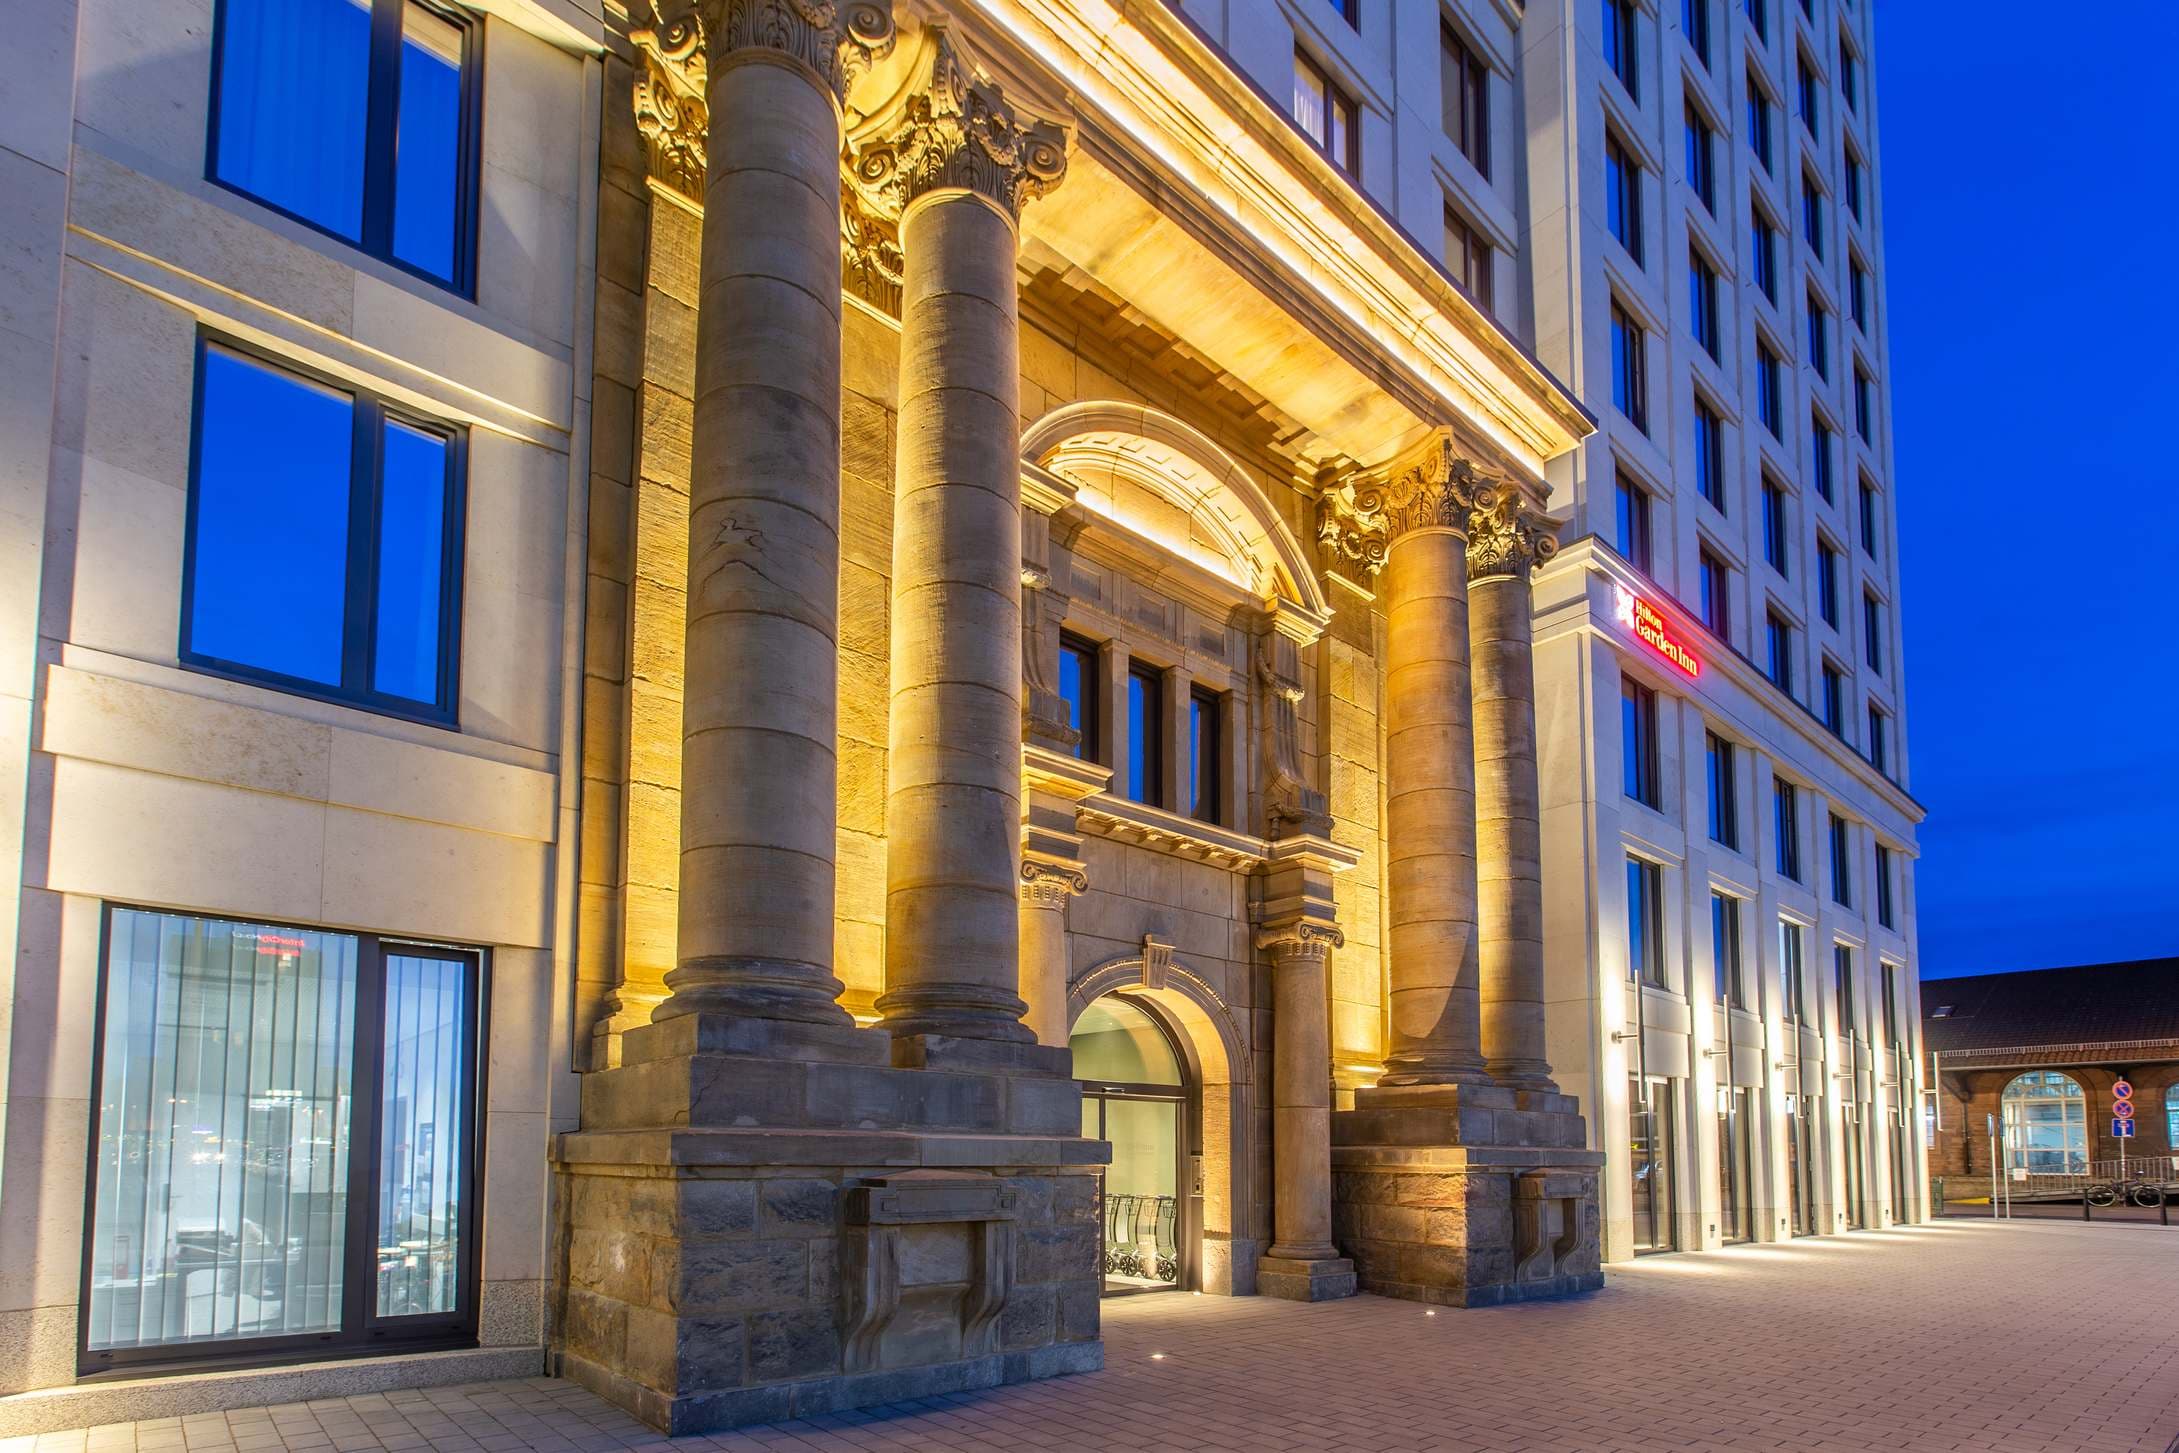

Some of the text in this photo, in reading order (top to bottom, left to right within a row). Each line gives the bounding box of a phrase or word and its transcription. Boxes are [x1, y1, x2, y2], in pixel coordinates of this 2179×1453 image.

[1636, 599, 1662, 631] Hilton
[1635, 615, 1697, 677] Garden Inn
